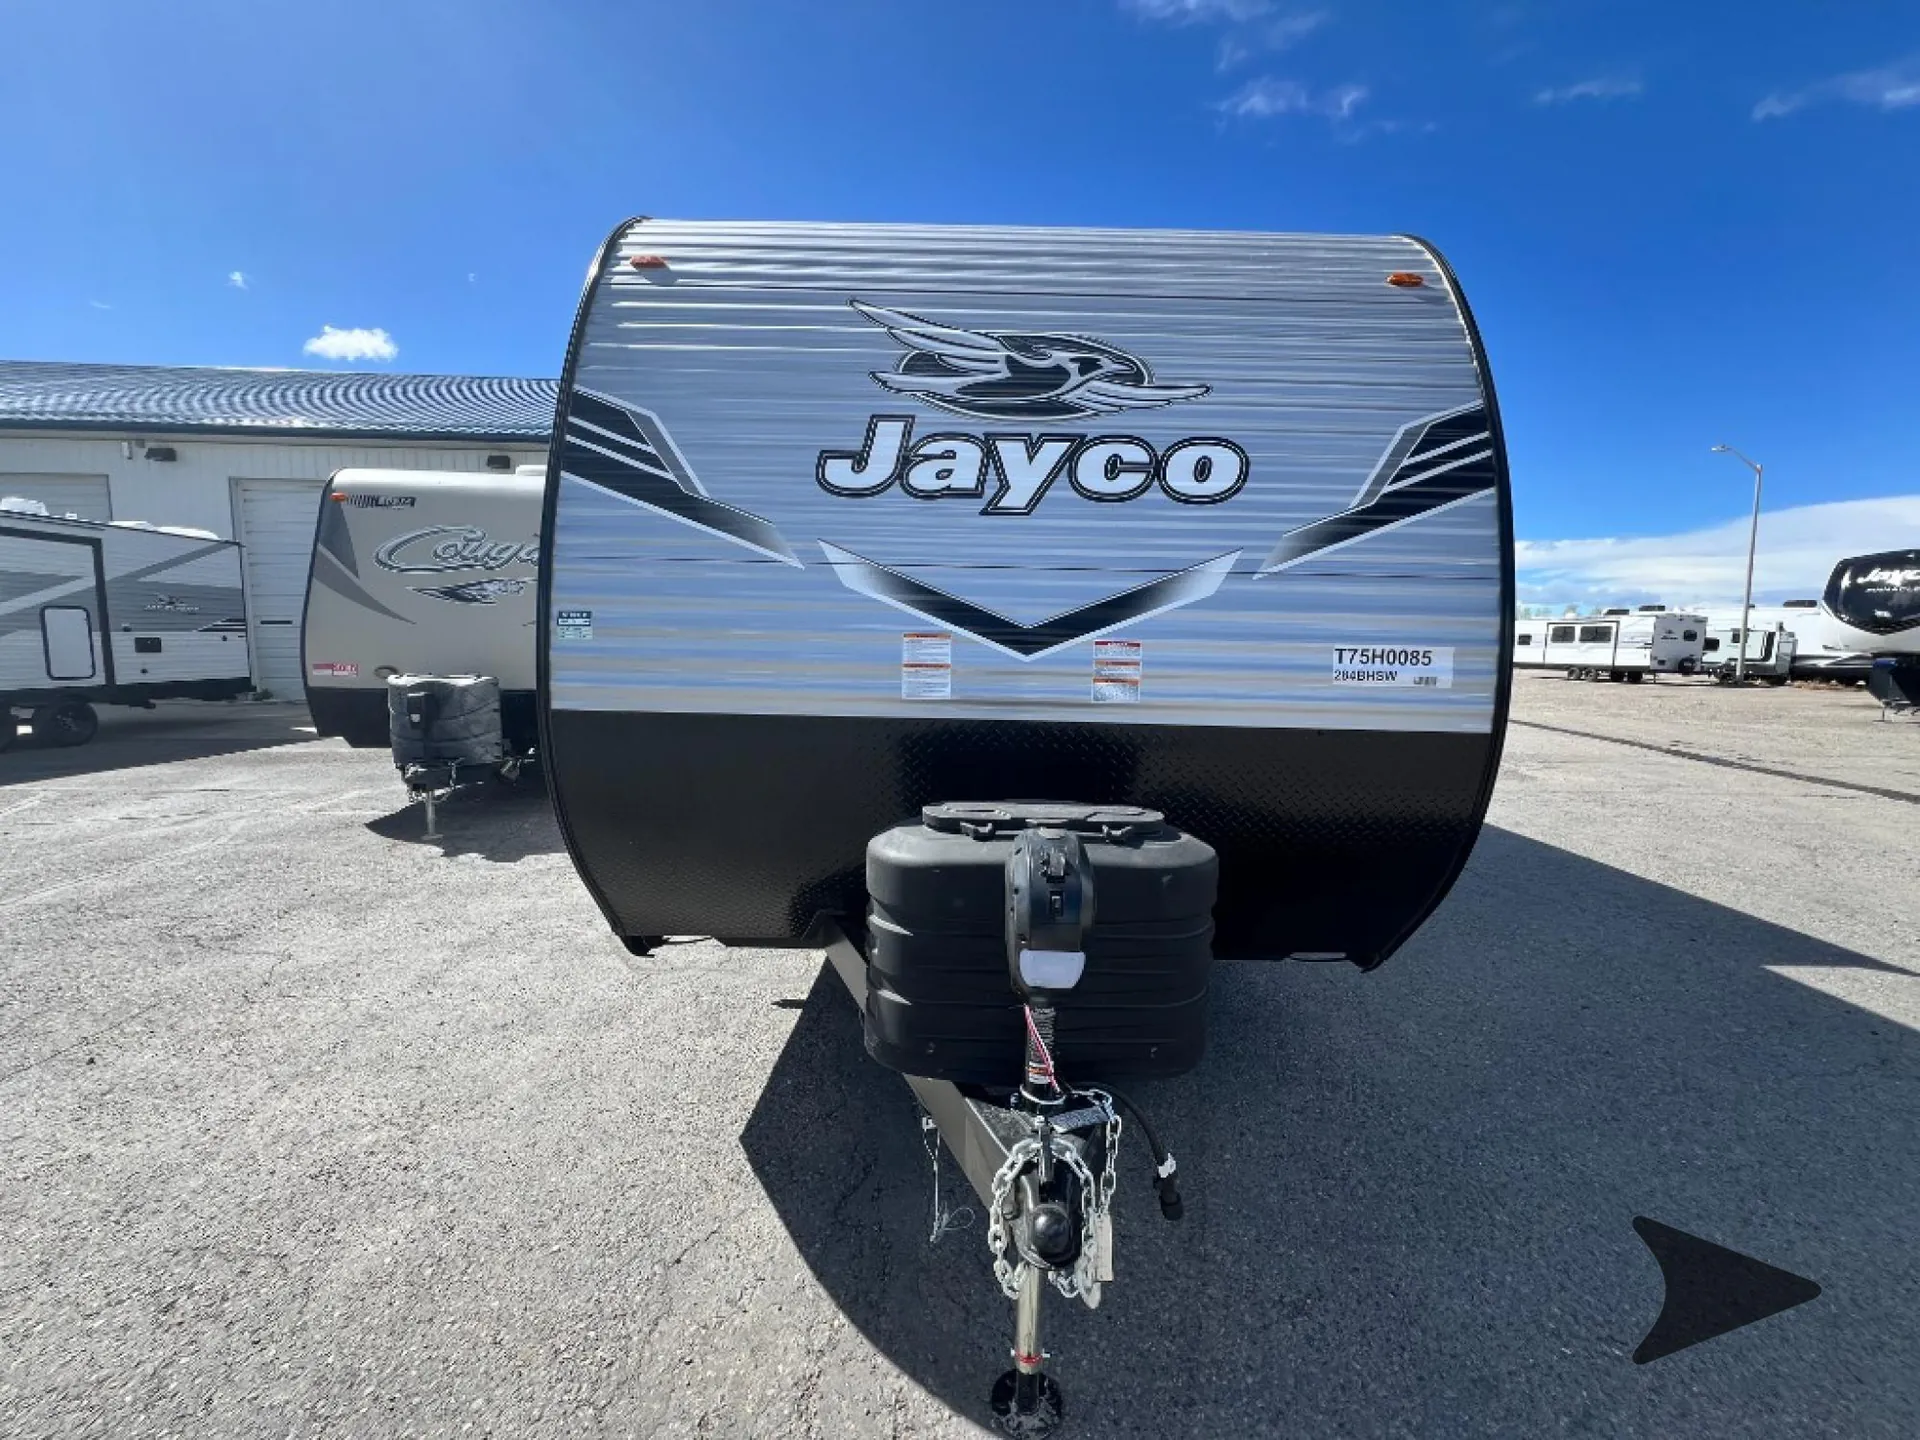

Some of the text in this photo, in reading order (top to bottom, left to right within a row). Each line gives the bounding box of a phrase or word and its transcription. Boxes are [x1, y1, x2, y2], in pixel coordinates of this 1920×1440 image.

[815, 414, 1250, 516] Jayco
[372, 524, 541, 573] Couga
[1856, 567, 1920, 587] Jayc
[1334, 648, 1433, 667] T75H0085
[1334, 670, 1398, 682] 284BHSW
